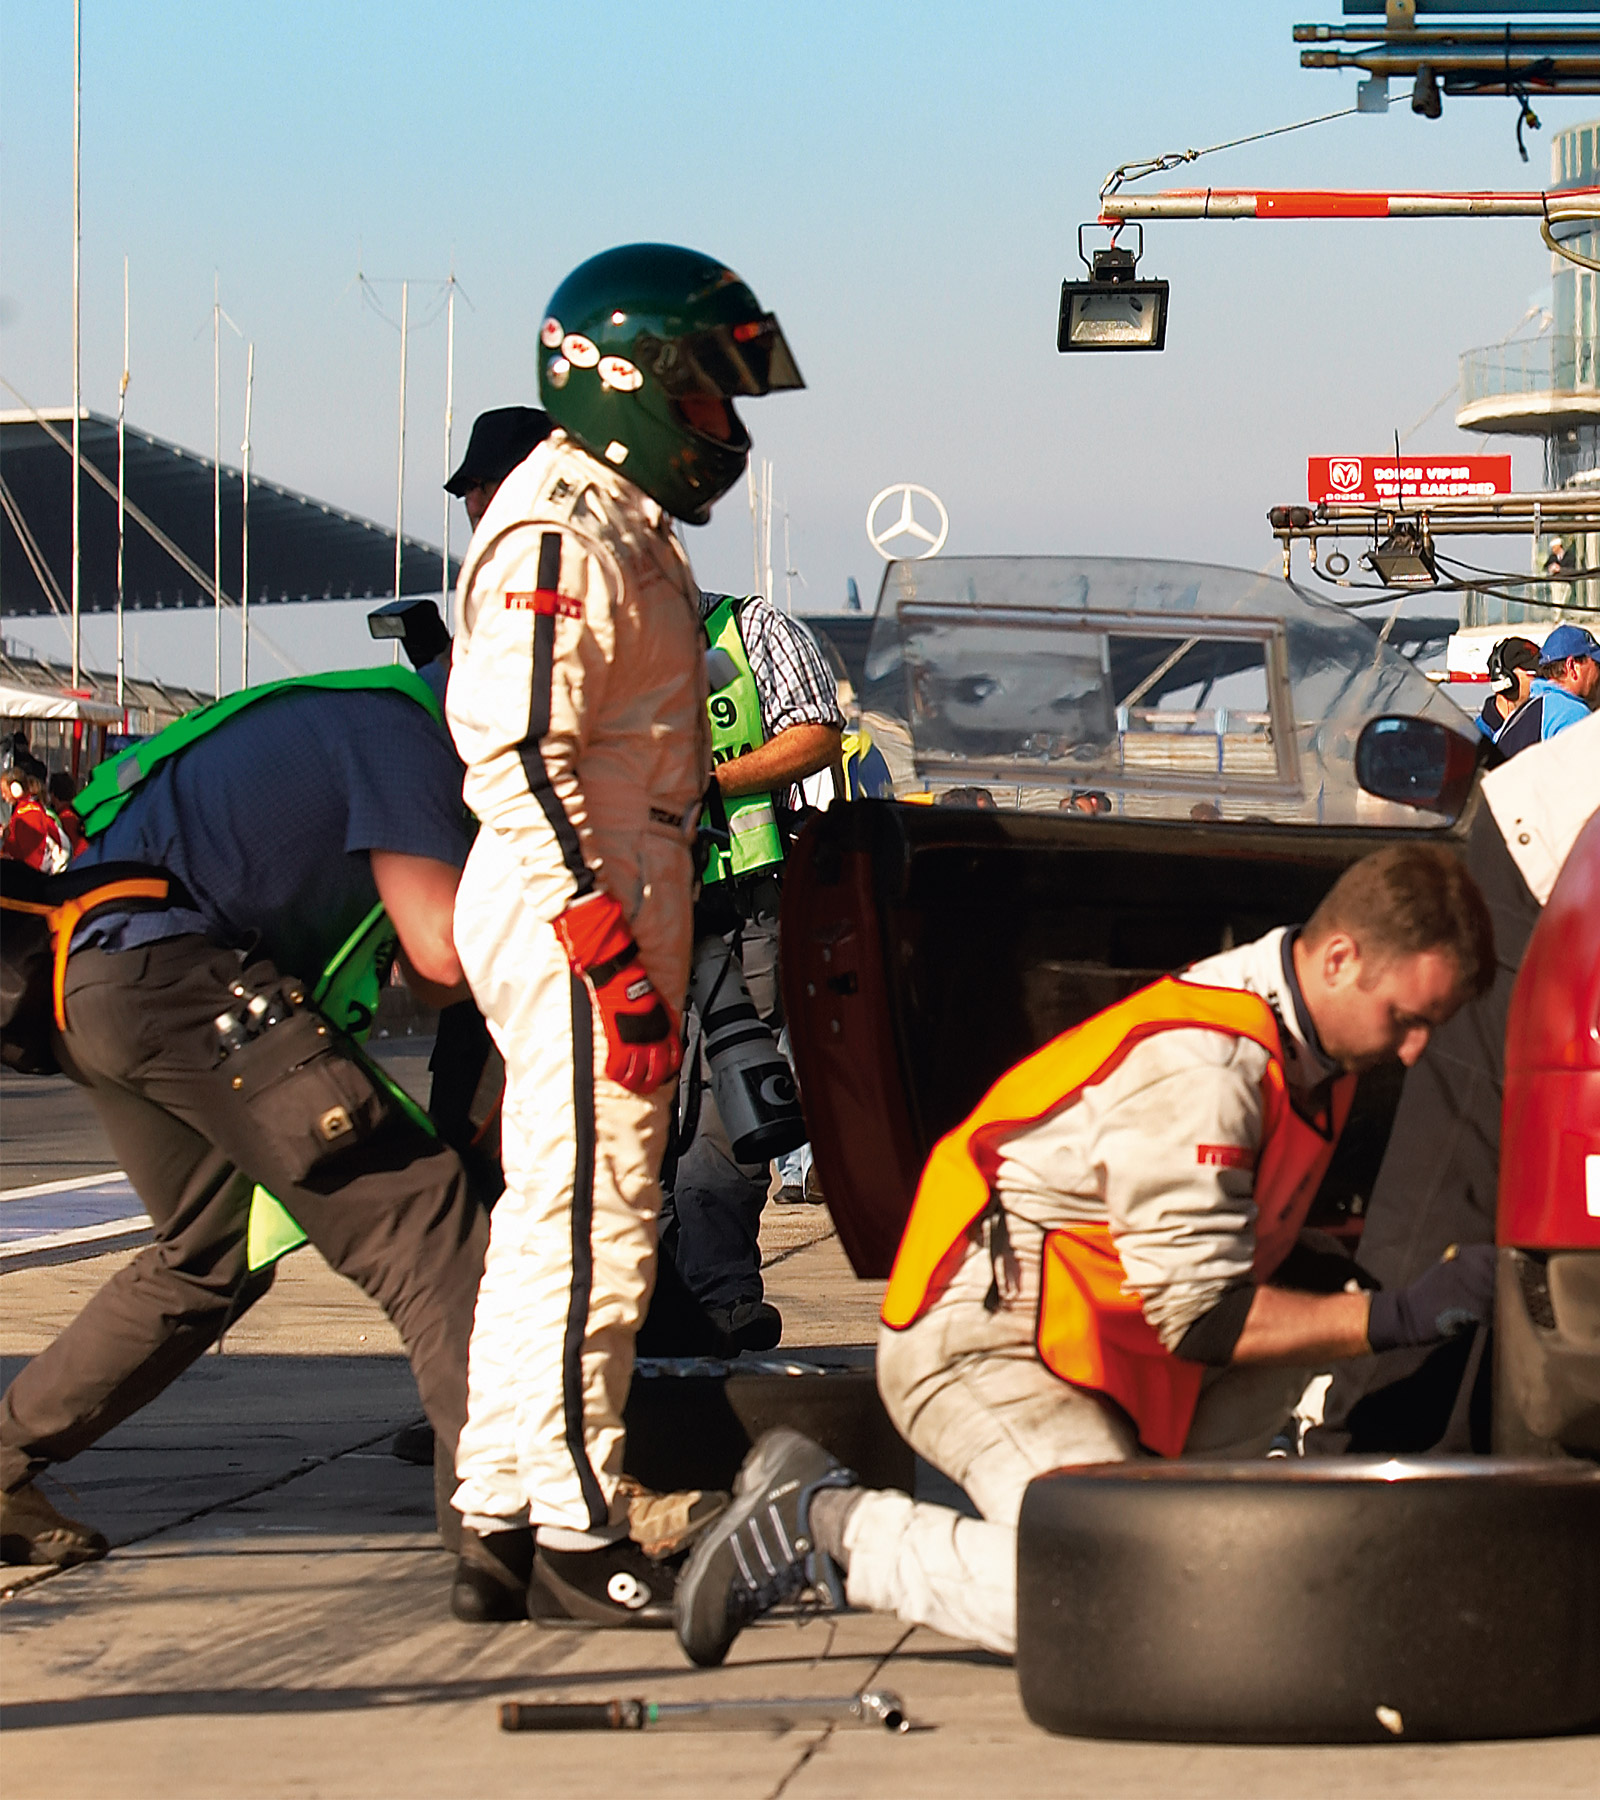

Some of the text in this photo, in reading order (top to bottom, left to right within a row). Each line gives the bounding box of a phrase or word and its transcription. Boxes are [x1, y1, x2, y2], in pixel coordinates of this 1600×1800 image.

[1373, 466, 1470, 481] DODGE VIPER
[1375, 482, 1496, 495] TEAM ZAKSPEED
